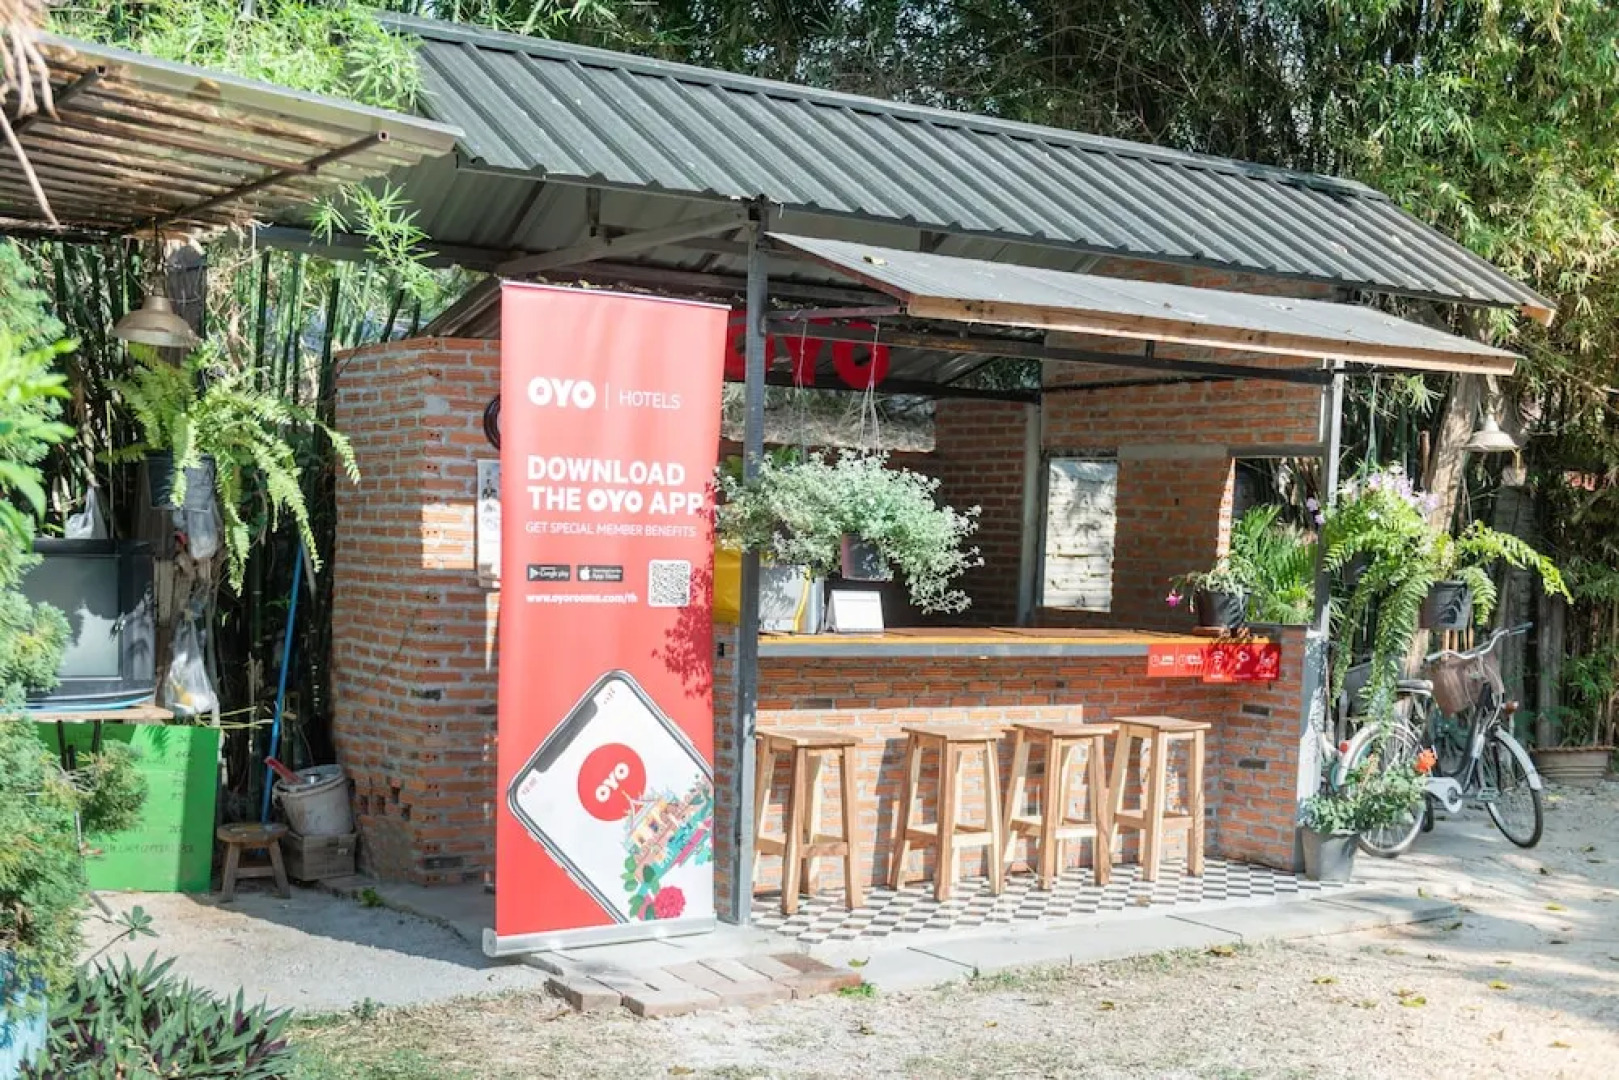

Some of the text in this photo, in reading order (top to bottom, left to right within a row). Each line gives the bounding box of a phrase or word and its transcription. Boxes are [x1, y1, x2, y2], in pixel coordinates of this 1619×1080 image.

[527, 376, 681, 409] OYO HOTELS
[527, 454, 686, 487] DOWNLOAD
[526, 486, 704, 516] THE OYO APP
[525, 520, 697, 538] GET SPECIAL MEMBER BENEFITS
[595, 762, 629, 803] OYO
